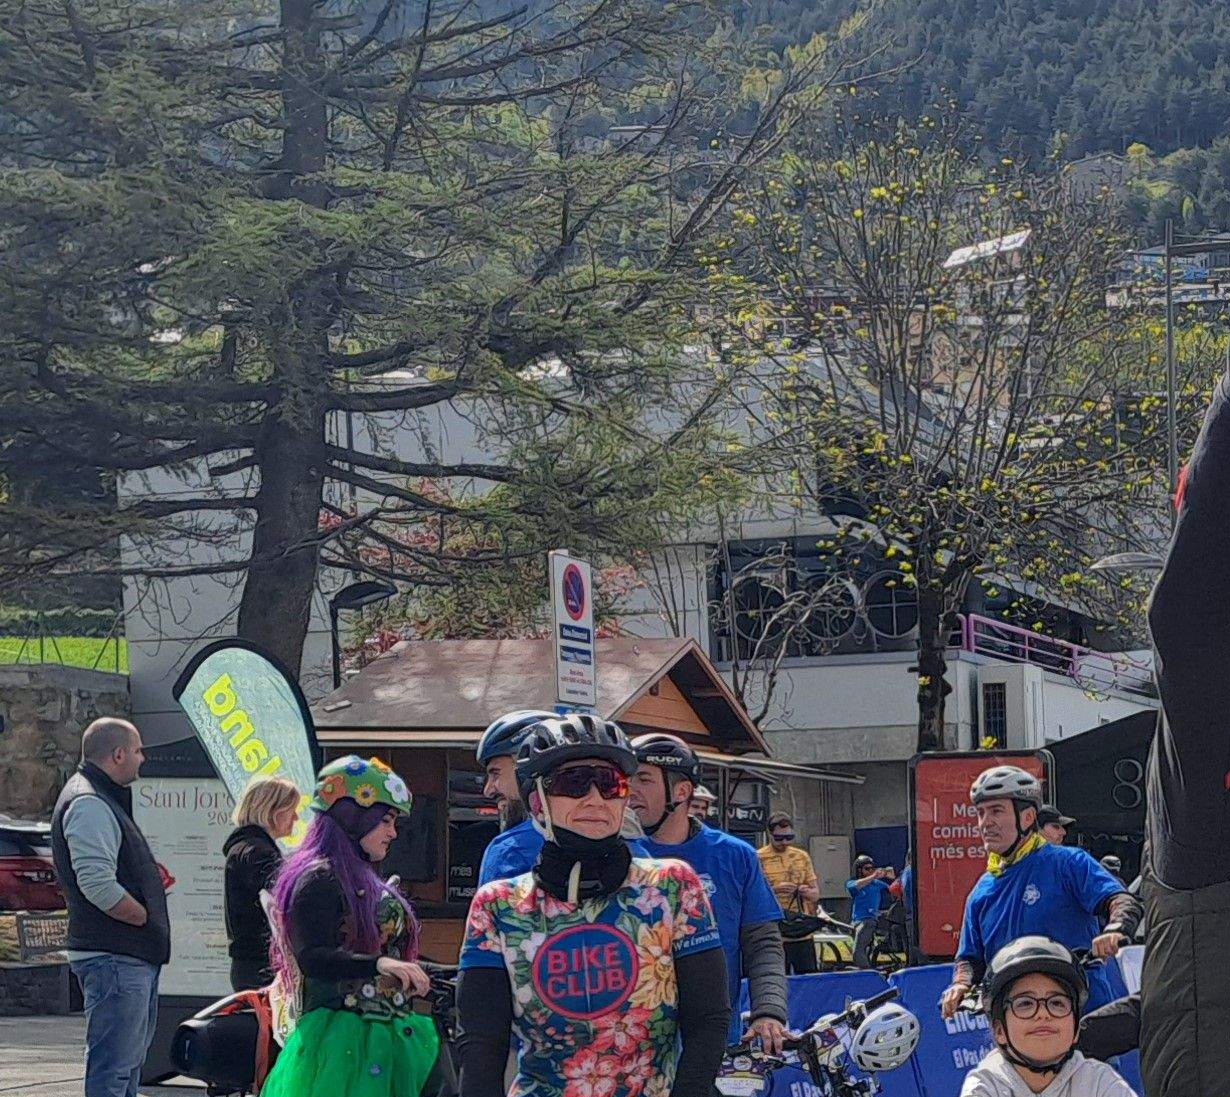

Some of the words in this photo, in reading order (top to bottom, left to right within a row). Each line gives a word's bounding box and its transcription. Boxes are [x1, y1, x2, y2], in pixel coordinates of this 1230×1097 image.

[646, 755, 683, 766] RUDY
[952, 803, 977, 818] Me
[933, 822, 980, 839] comis
[931, 842, 964, 860] més
[967, 846, 986, 859] es
[548, 942, 621, 974] BIKE
[548, 968, 627, 999] CLUB
